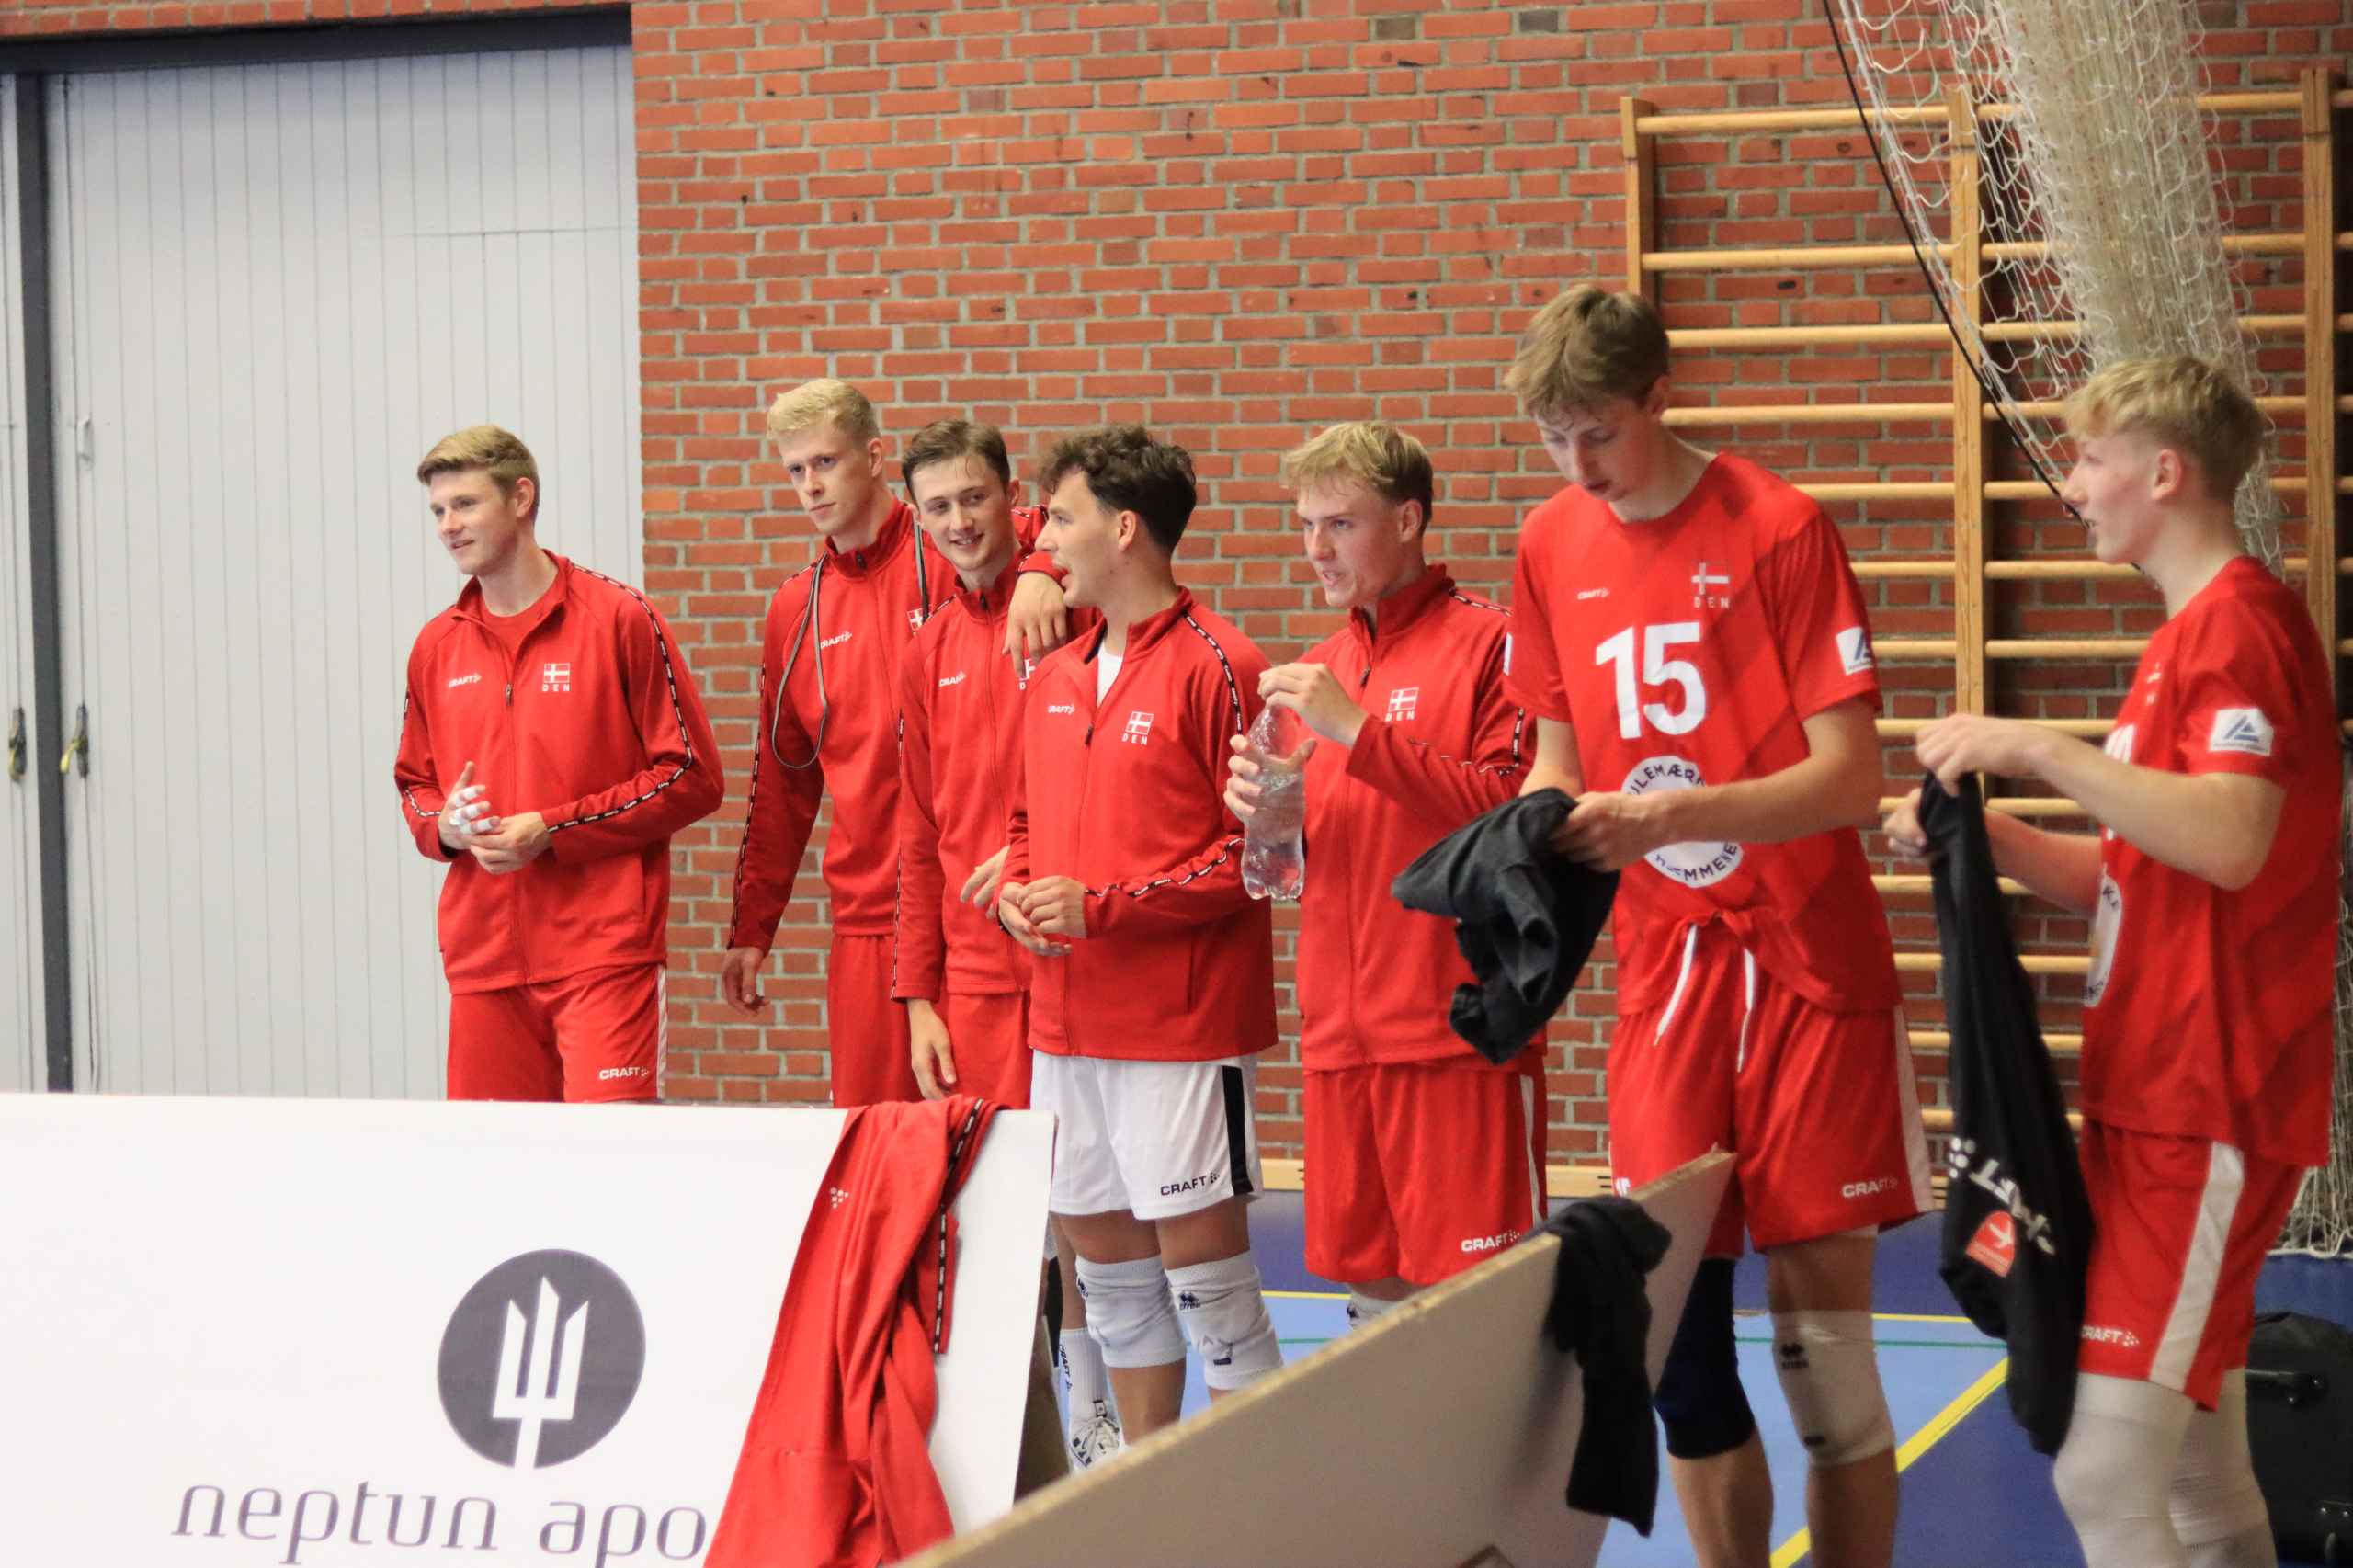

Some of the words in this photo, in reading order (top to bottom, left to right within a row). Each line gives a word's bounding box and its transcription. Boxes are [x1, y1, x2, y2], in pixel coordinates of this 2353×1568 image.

[1694, 597, 1730, 608] DEN
[1596, 621, 1707, 739] 15
[1384, 710, 1415, 722] DEN
[1121, 733, 1148, 745] DEN
[599, 1066, 641, 1080] CRAFT
[1160, 1176, 1207, 1196] CRAFT
[1842, 1178, 1889, 1198] CRAFT
[1461, 1233, 1508, 1252] CRAFT
[171, 1481, 498, 1565] neptun
